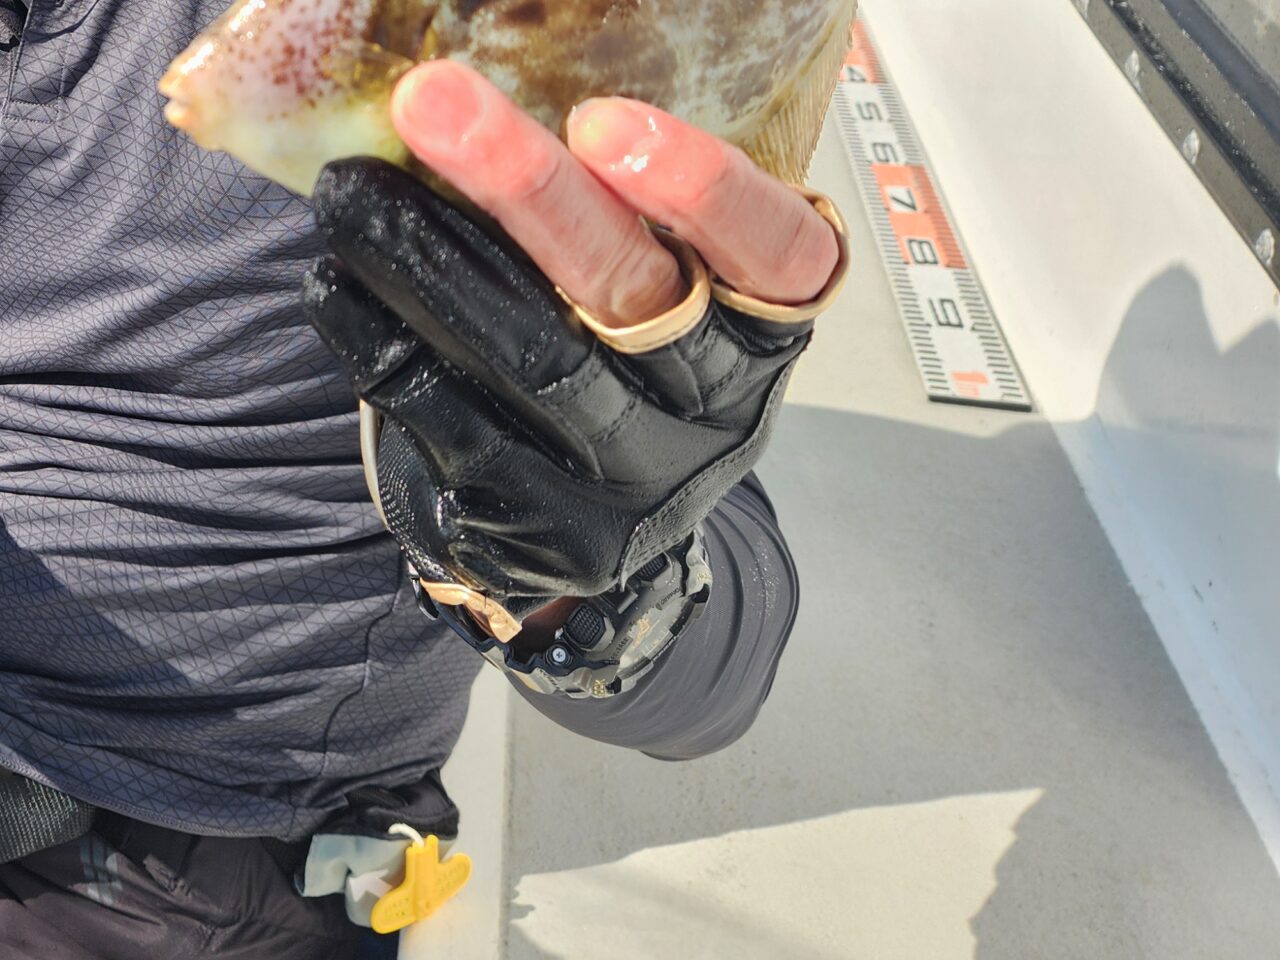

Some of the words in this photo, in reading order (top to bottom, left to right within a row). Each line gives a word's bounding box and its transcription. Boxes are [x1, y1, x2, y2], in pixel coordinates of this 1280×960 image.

[856, 100, 883, 122] 5
[871, 142, 899, 163] 6
[889, 187, 918, 212] 7
[907, 238, 939, 265] 8
[927, 298, 964, 329] 9
